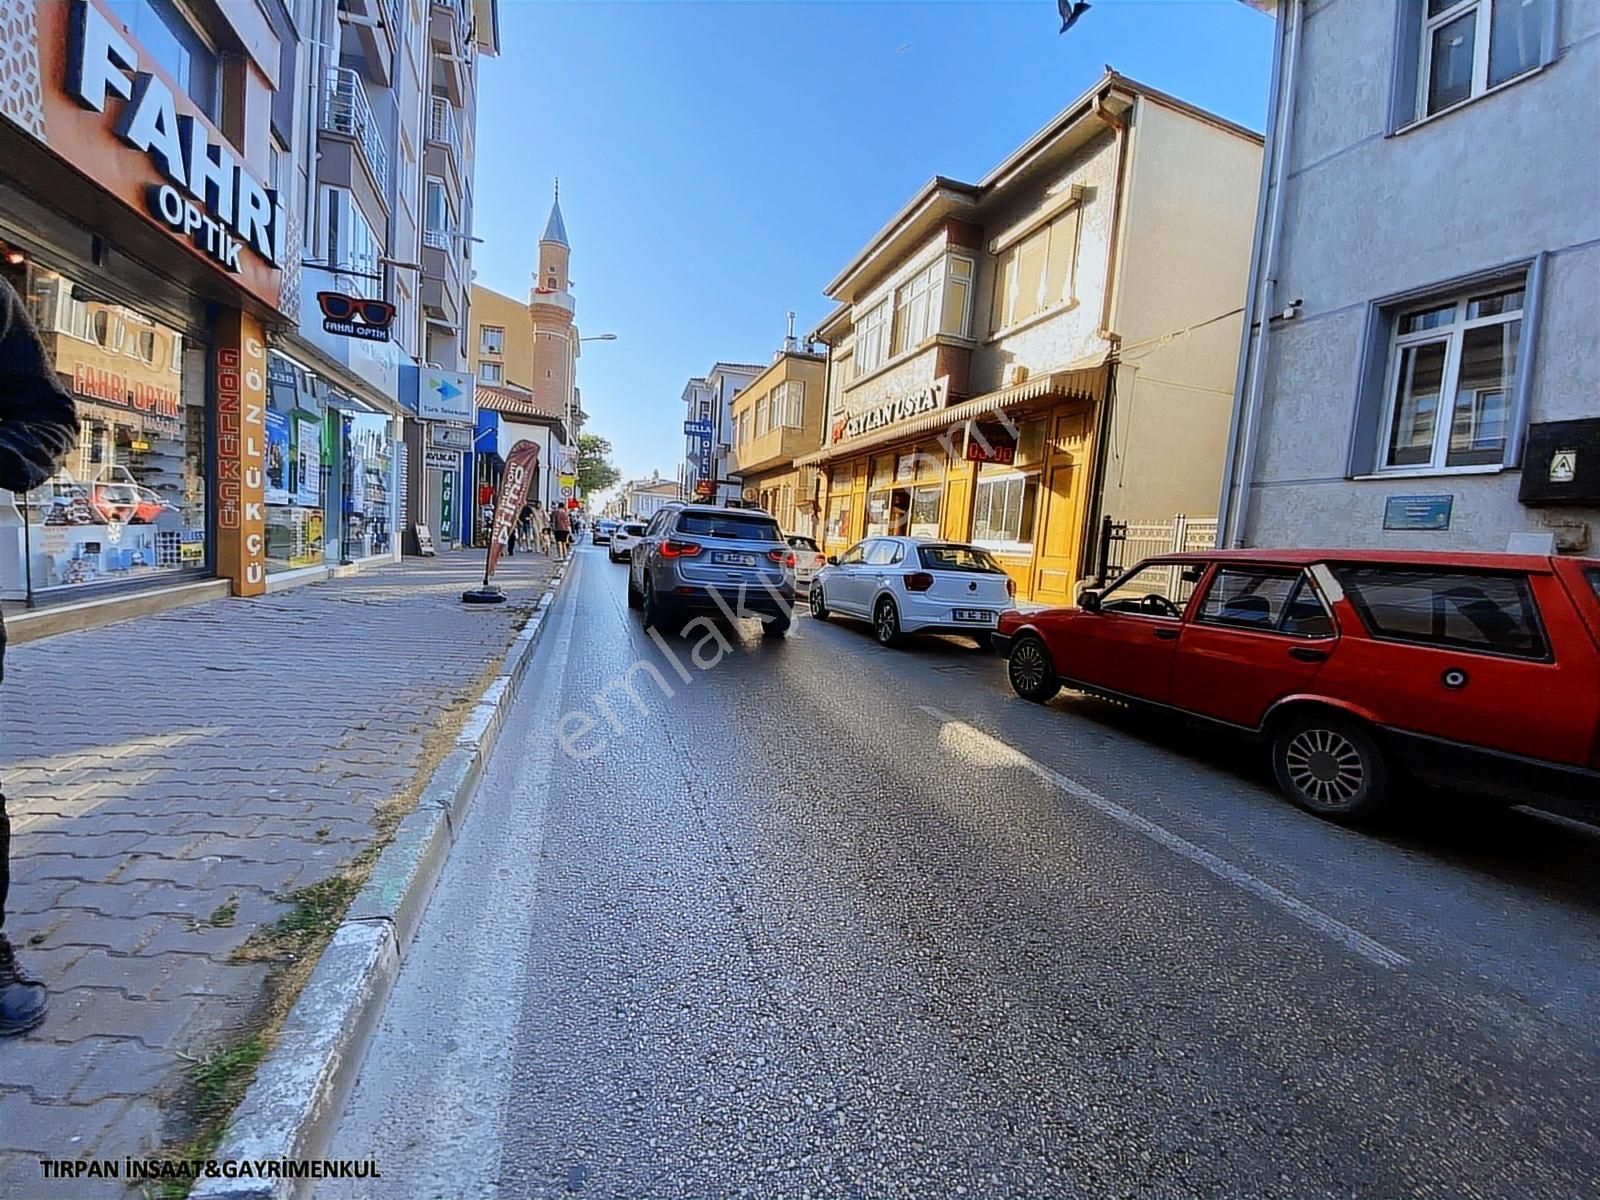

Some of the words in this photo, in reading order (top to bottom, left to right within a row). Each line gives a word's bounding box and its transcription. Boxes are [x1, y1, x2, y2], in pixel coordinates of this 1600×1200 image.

[79, 1, 287, 270] FAHRİ
[158, 184, 244, 274] OPTİK
[896, 387, 937, 419] USTA
[246, 338, 263, 583] GÖZLÜKÇÜ
[702, 440, 710, 474] OTEL
